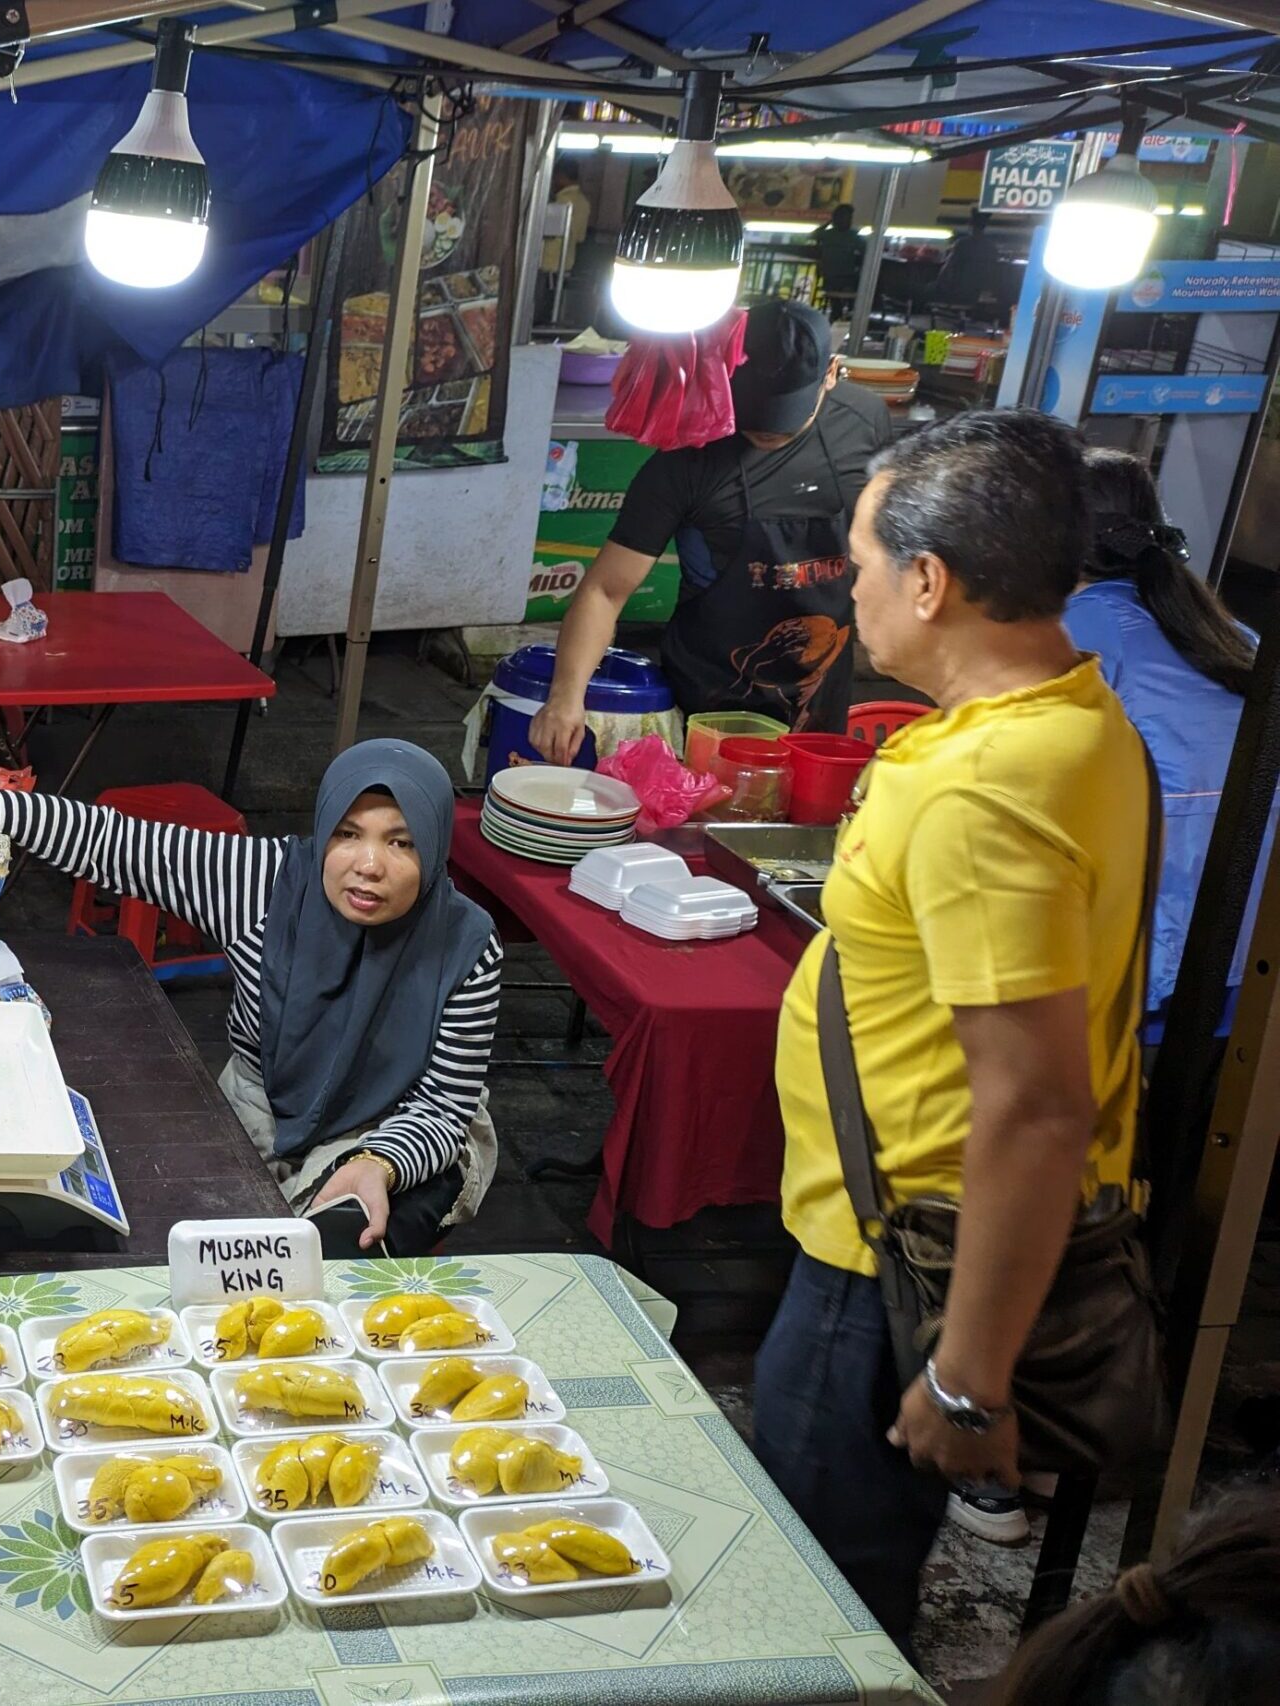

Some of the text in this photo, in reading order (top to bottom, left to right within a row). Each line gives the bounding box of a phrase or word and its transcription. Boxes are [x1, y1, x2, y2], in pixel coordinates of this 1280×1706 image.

[989, 166, 1062, 188] HALAL
[992, 187, 1054, 207] FOOD
[1185, 275, 1279, 286] Naturally Refreshing
[1172, 288, 1218, 297] Mountain
[1221, 288, 1256, 297] Mineral
[1259, 288, 1280, 297] Wate
[528, 573, 577, 593] MILO
[199, 1235, 292, 1266] MUSANG
[200, 1338, 232, 1360] 35
[367, 1332, 403, 1348] 35
[76, 1497, 110, 1520] 35
[259, 1488, 289, 1511] 35
[306, 1570, 337, 1592] 20
